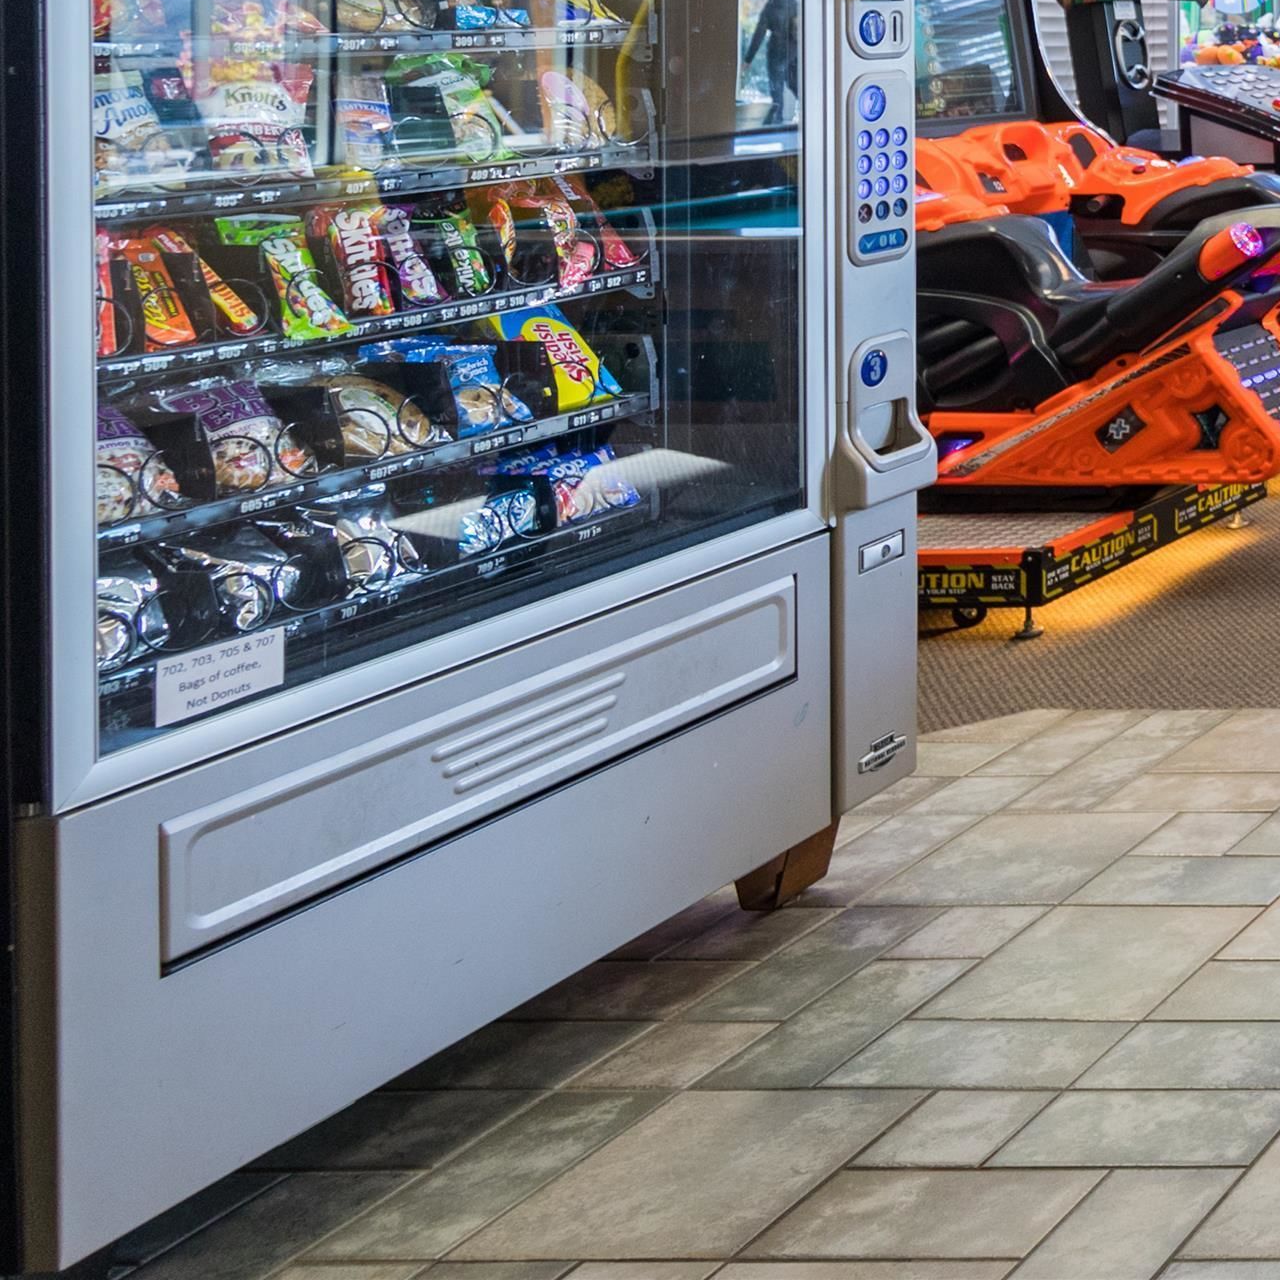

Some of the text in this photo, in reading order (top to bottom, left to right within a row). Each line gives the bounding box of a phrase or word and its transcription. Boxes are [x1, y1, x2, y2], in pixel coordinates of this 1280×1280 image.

[224, 83, 288, 112] Knott's
[879, 233, 897, 247] OK
[335, 210, 377, 313] Skittles
[531, 322, 592, 383] Swedish
[556, 331, 592, 366] Fish
[1198, 483, 1249, 512] CAUTION
[1071, 531, 1136, 571] CAUTION
[947, 588, 967, 596] STEP
[991, 574, 1015, 584] STAY
[991, 583, 1015, 591] BACK
[162, 634, 276, 678] 702, 703, 705 & 707
[178, 677, 206, 693] Bags
[208, 671, 221, 683] of
[186, 683, 252, 710] Not Donuts
